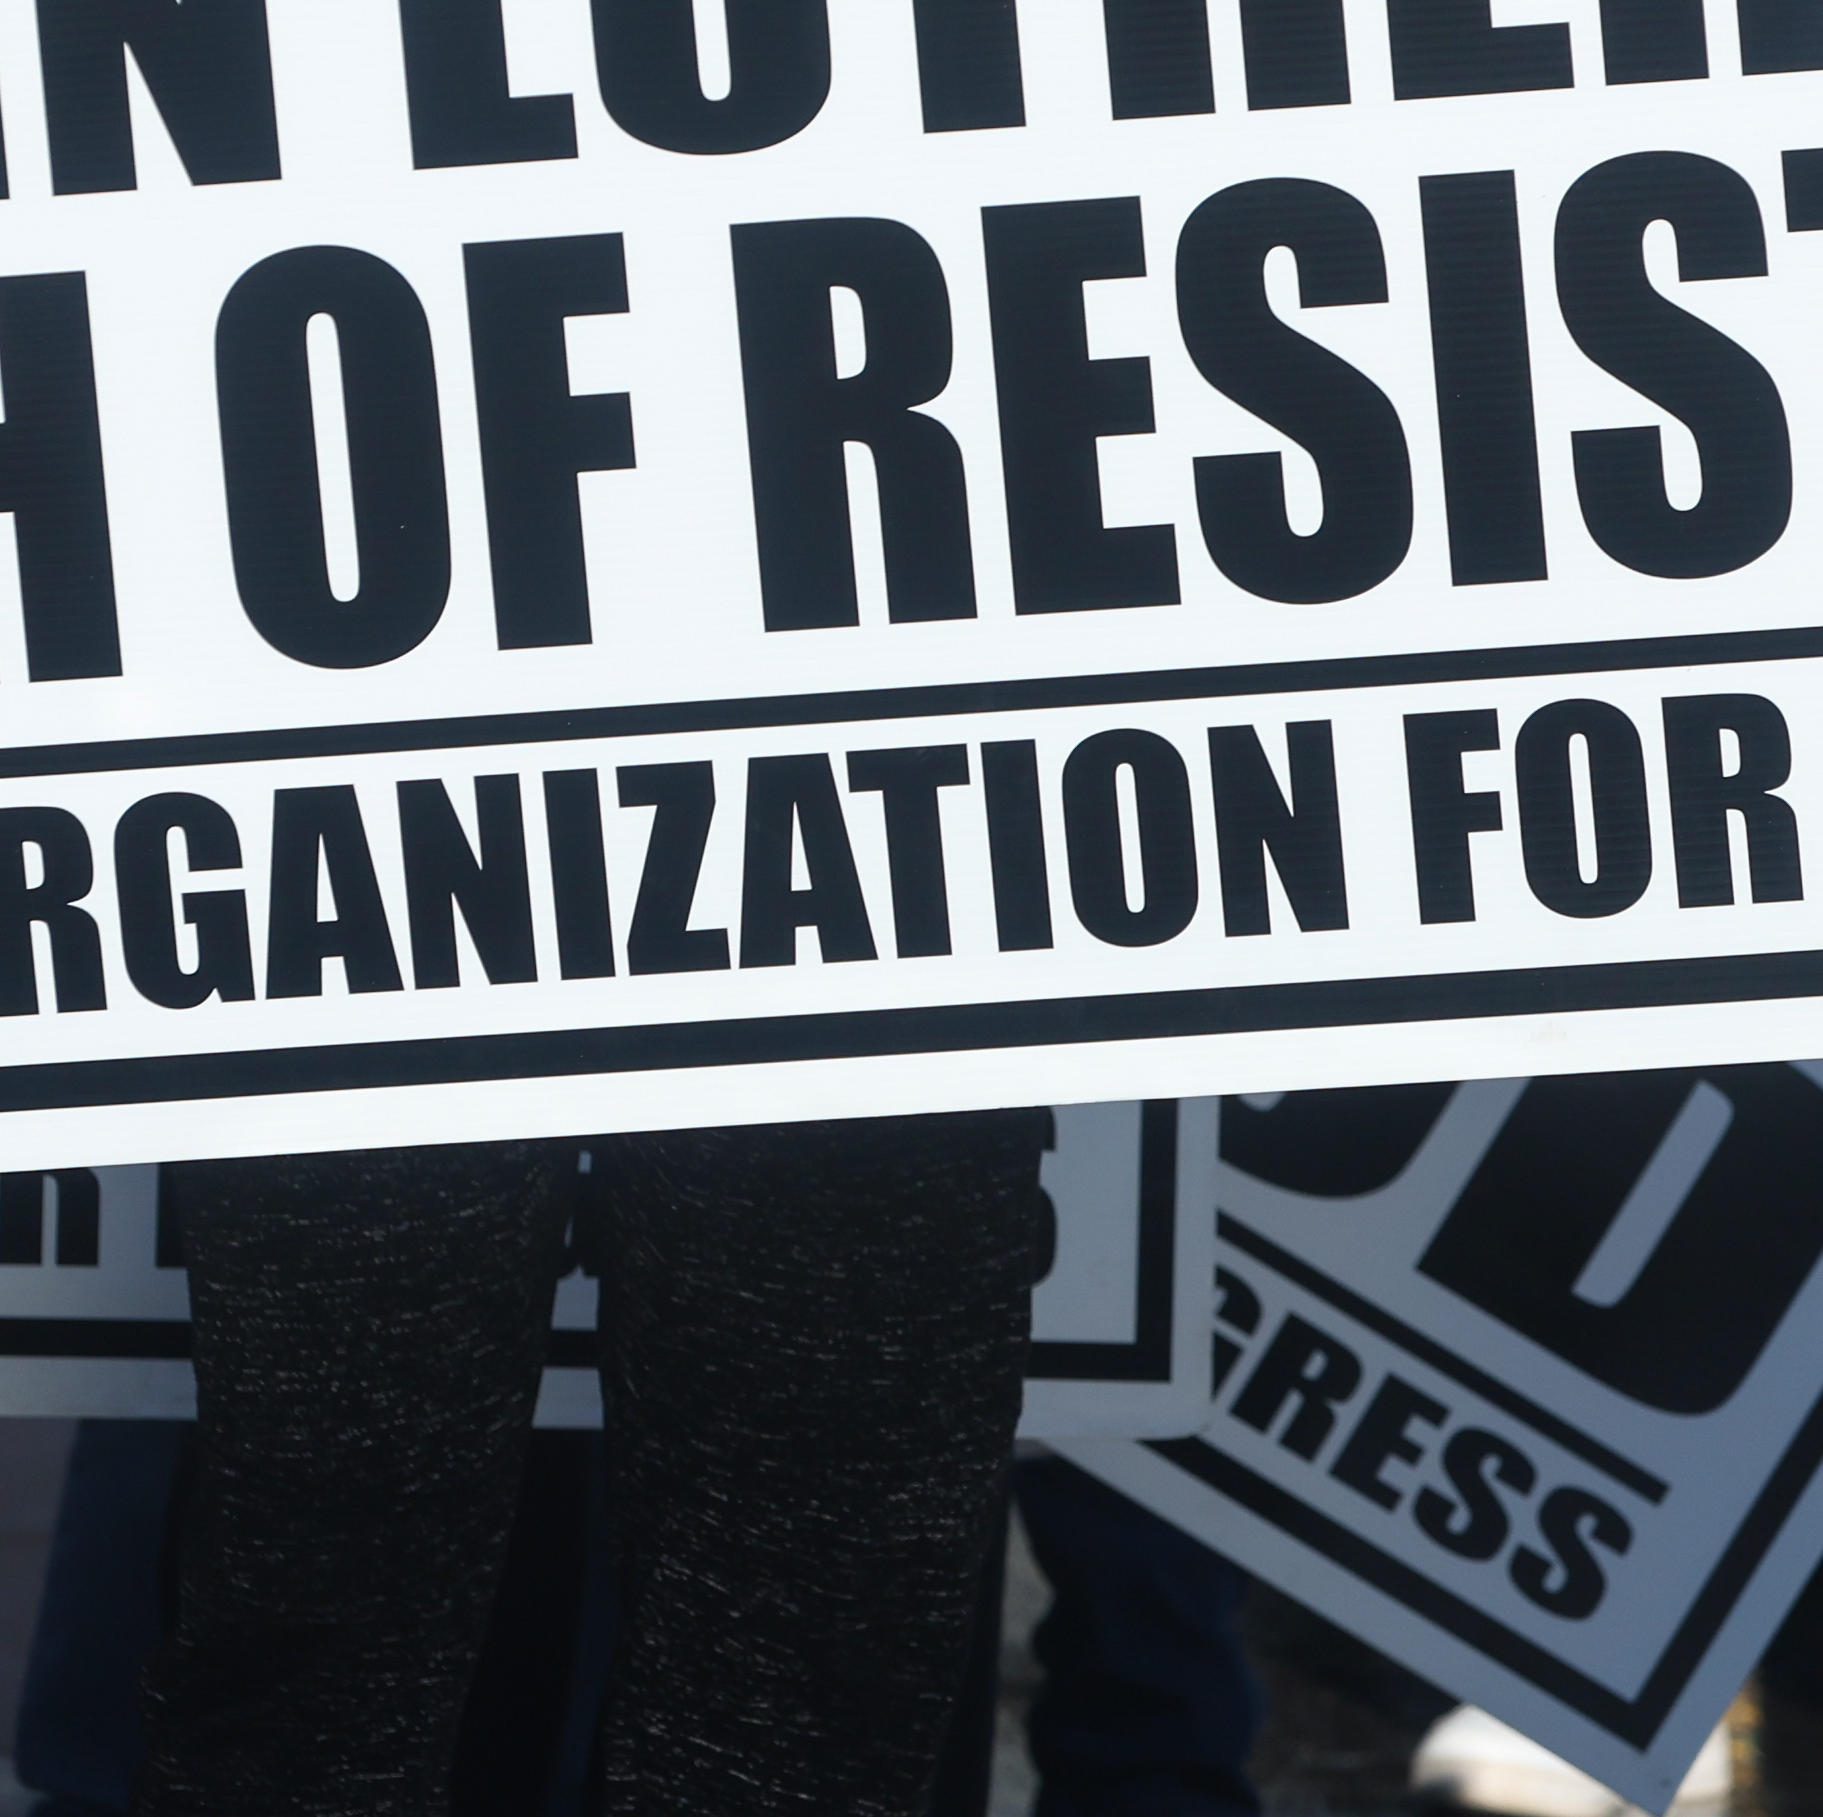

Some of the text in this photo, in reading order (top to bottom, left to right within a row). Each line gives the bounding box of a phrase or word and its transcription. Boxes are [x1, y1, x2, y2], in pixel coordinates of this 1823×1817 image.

[215, 232, 636, 669] OF
[1403, 694, 1803, 924] FOR
[1213, 1264, 1634, 1621] GRESS
